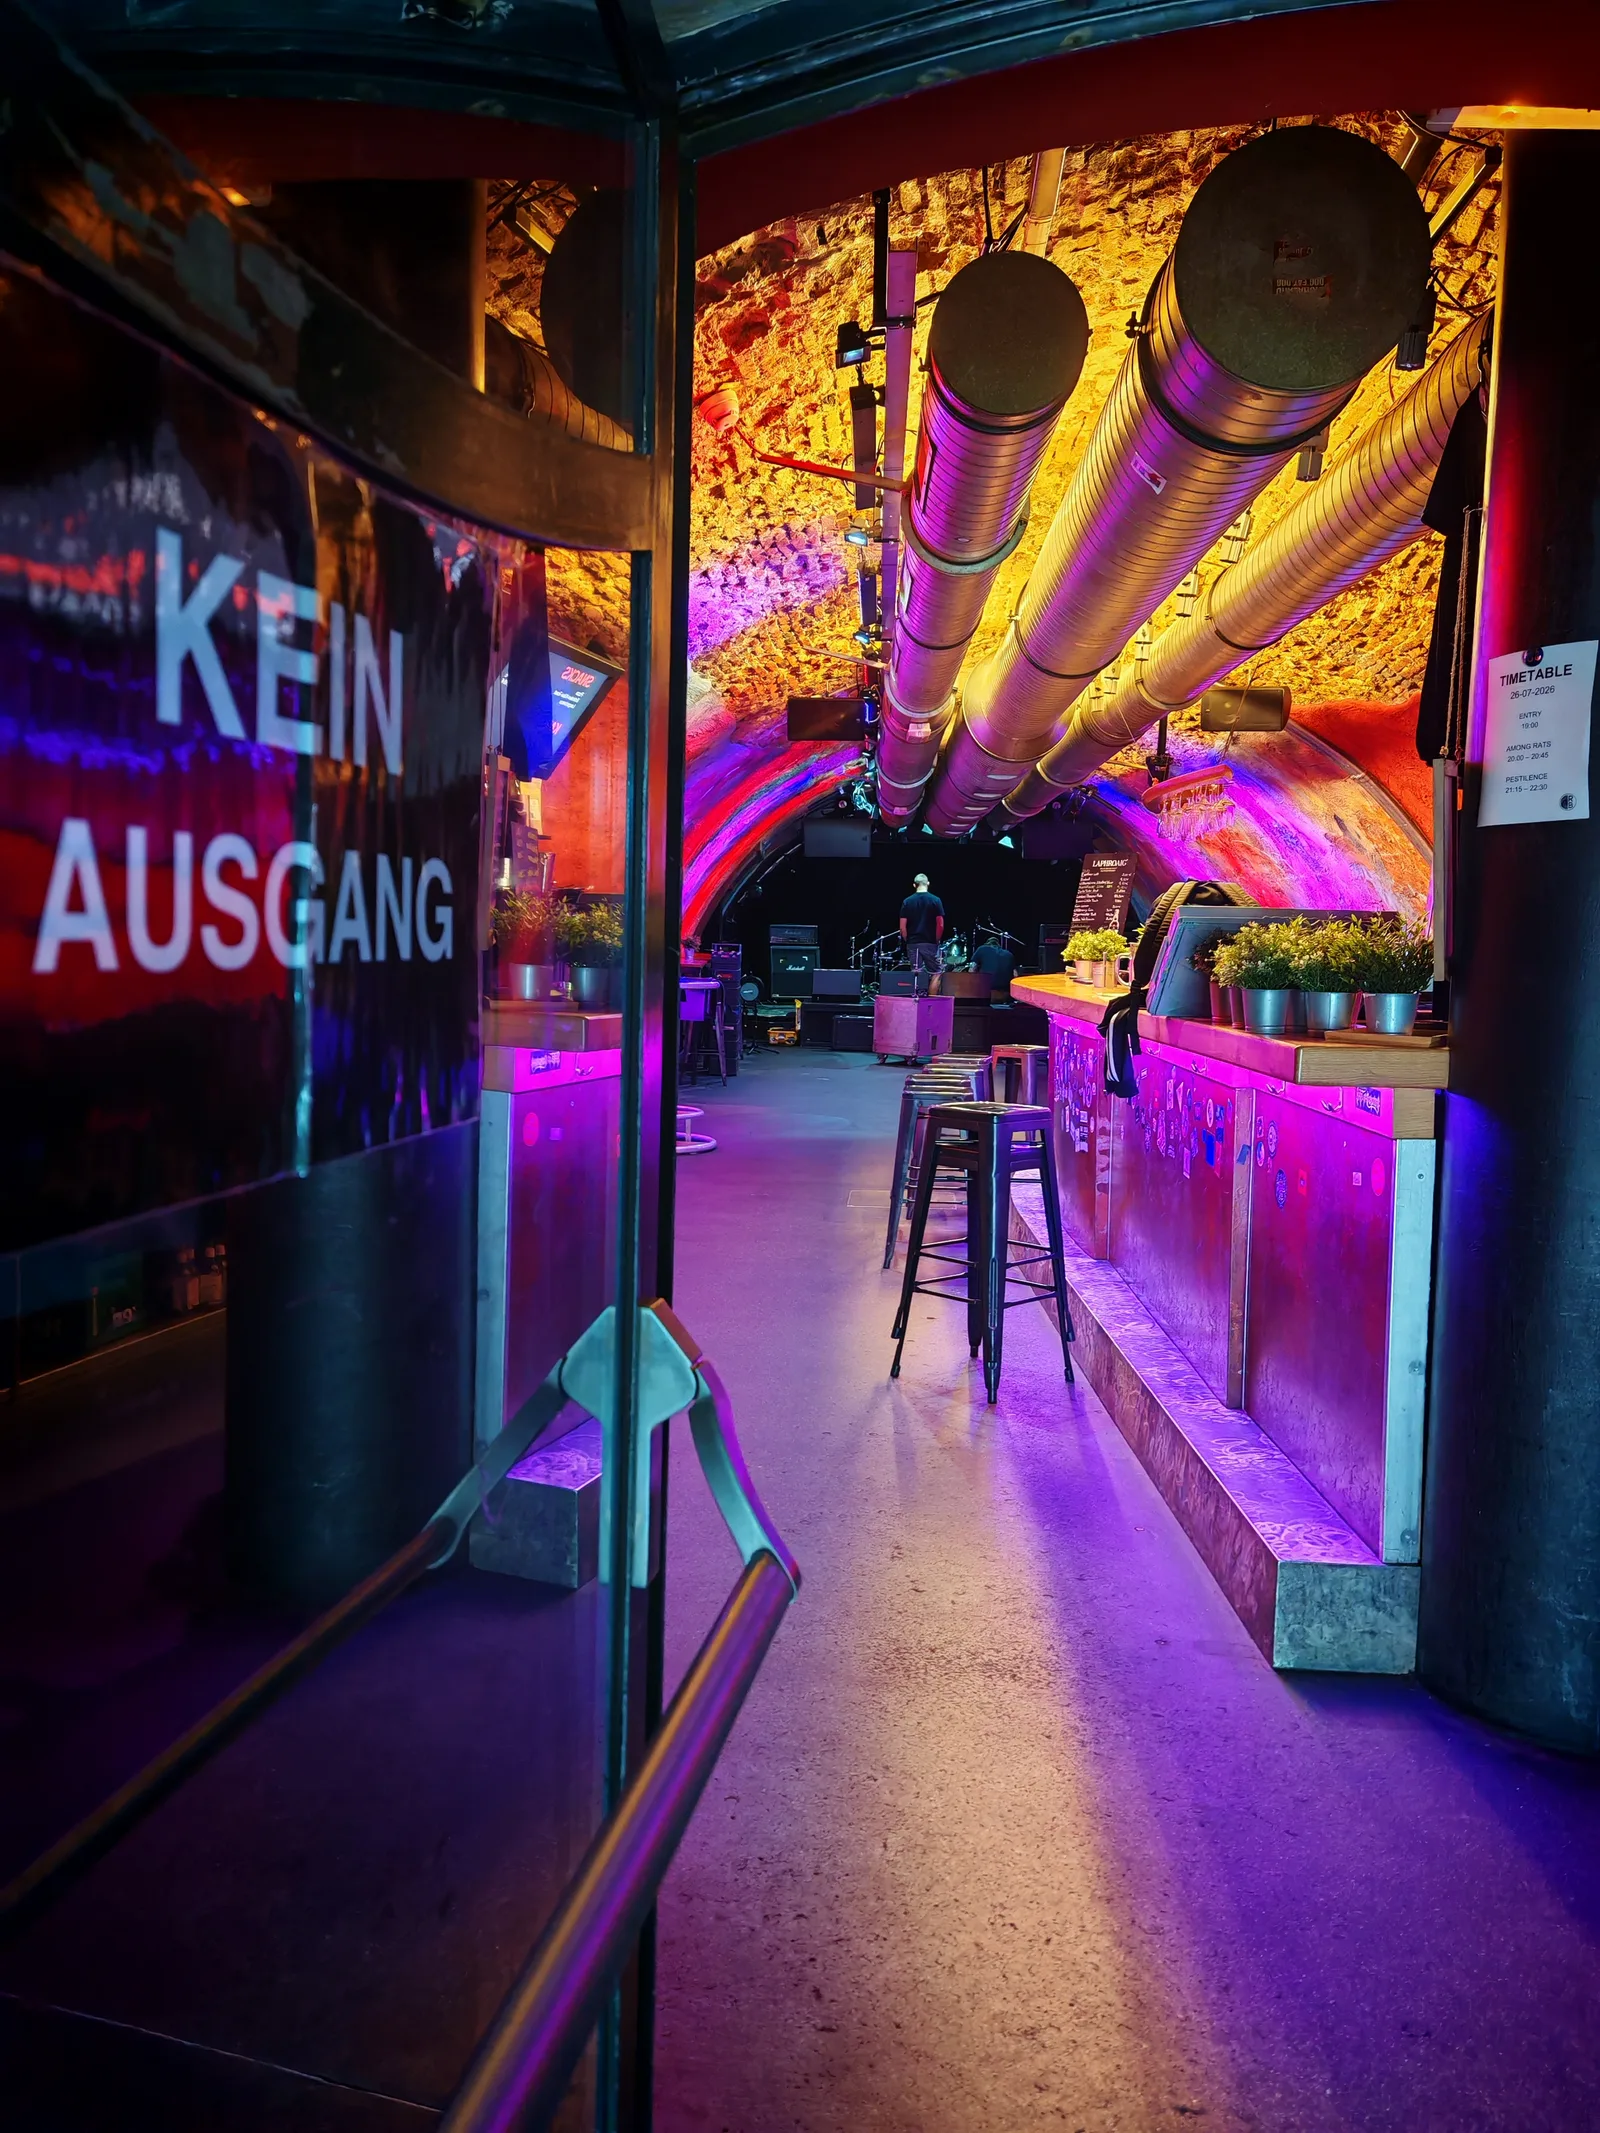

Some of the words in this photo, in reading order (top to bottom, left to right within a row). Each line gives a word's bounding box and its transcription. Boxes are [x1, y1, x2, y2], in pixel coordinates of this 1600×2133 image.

[156, 526, 404, 776] KEIN
[1500, 664, 1573, 687] TIMETABLE
[1510, 685, 1555, 699] 26-07-2026
[1519, 710, 1542, 720] ENTRY
[1521, 721, 1539, 729] 19:00
[1506, 743, 1531, 752] AMONG
[1532, 740, 1552, 749] RATS
[1505, 772, 1548, 783] PESTILENCE
[1505, 785, 1523, 793] 21:15
[32, 816, 454, 975] AUSGANG
